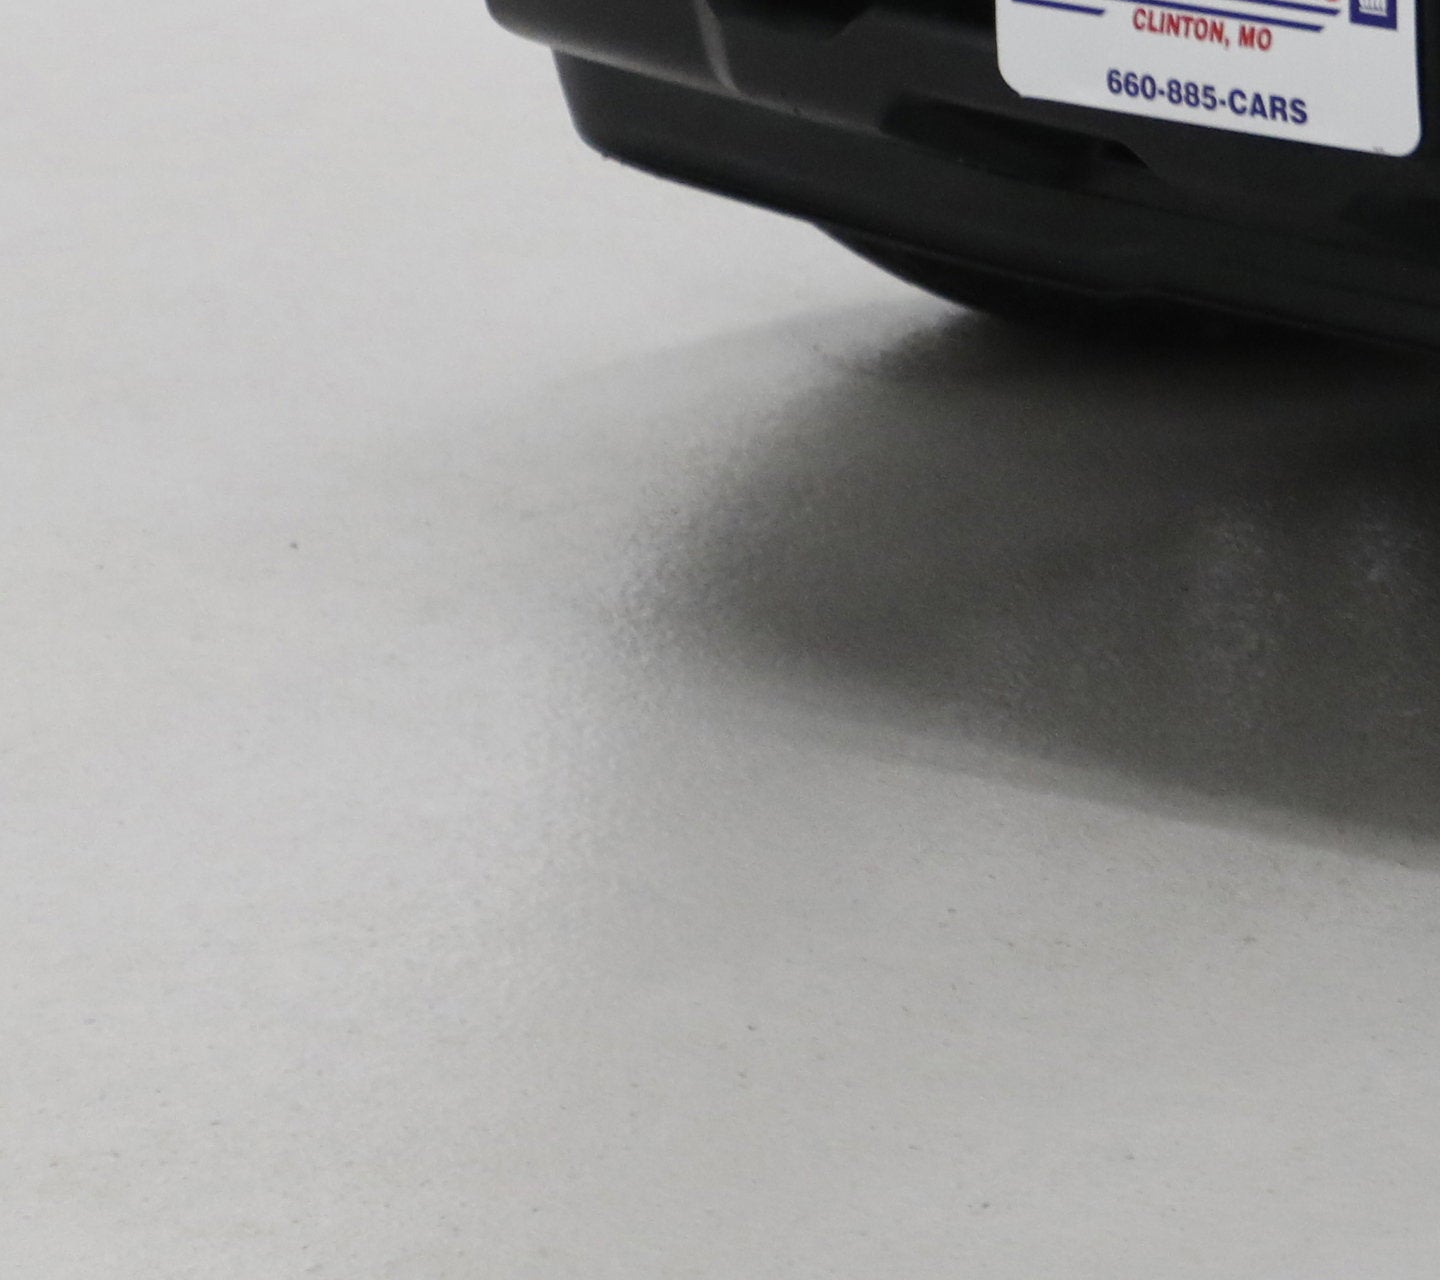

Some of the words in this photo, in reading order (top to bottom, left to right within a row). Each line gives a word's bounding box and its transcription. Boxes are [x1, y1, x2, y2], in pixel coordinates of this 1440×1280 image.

[1131, 7, 1230, 48] CLINTON,
[1238, 26, 1273, 51] MO
[1106, 69, 1309, 125] 660-885-CARS
